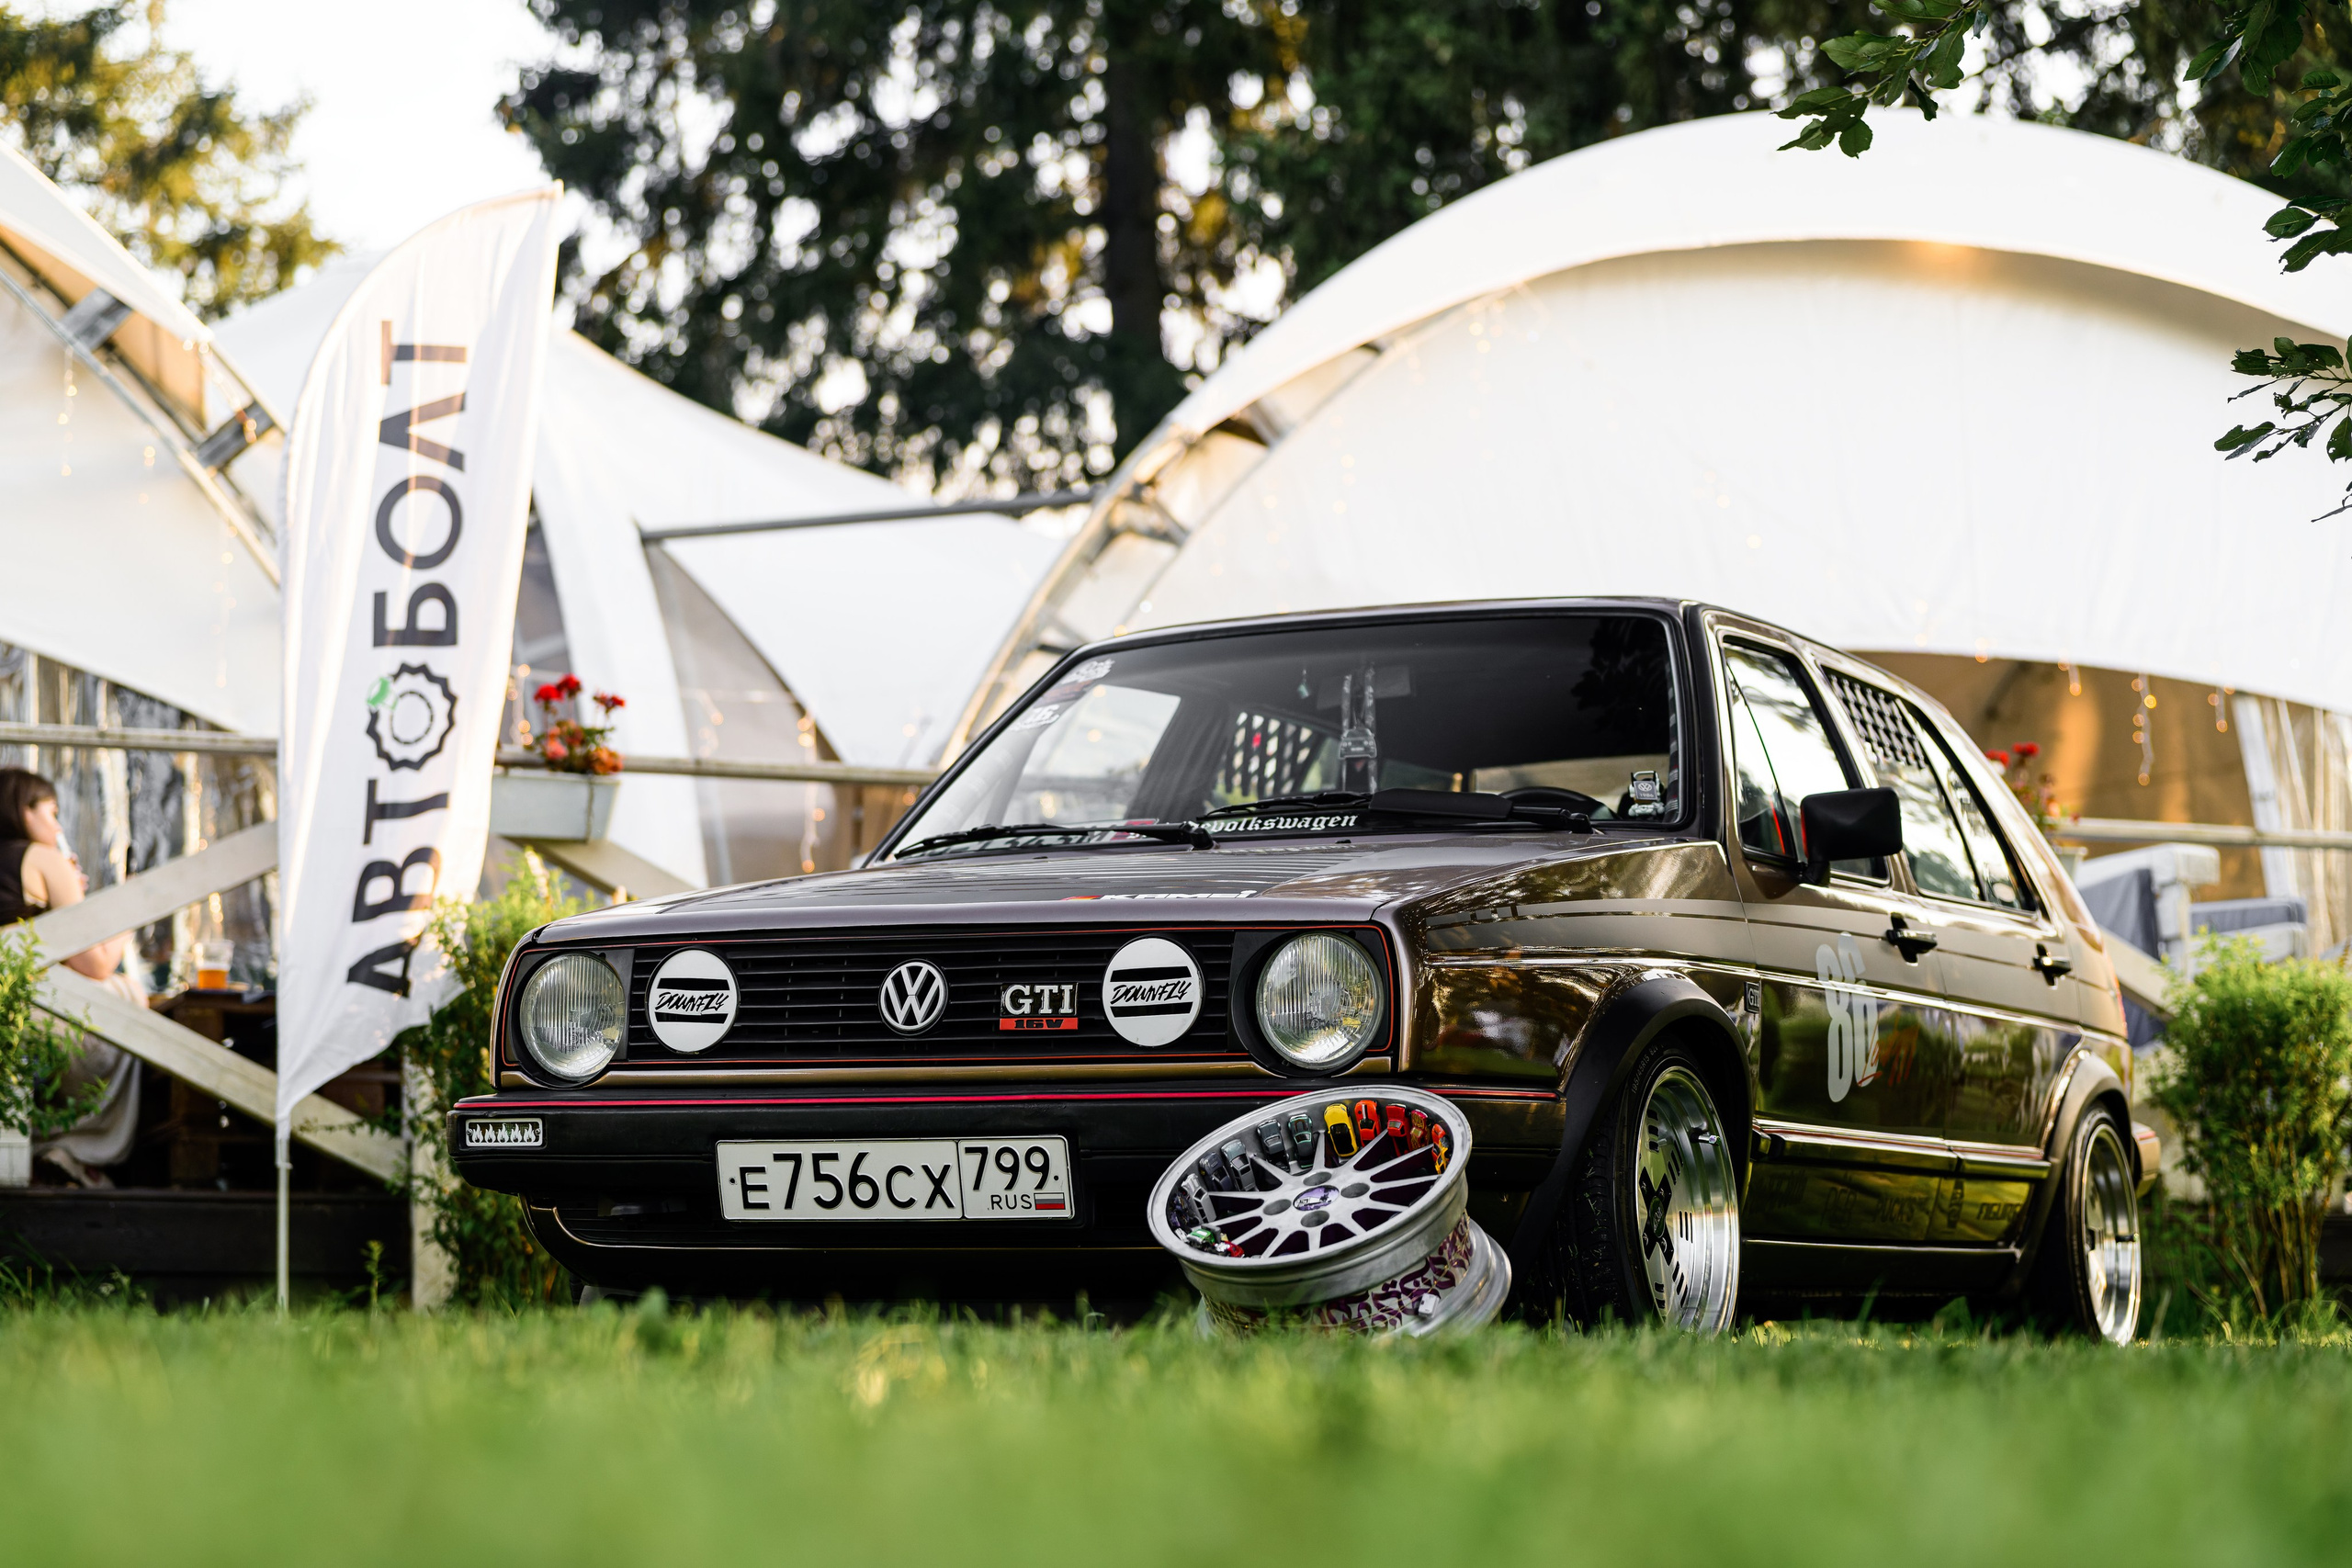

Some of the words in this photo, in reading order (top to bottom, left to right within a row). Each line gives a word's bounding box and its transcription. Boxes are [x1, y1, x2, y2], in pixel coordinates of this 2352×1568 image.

[1004, 984, 1074, 1015] GTI
[1014, 1019, 1064, 1029] 16V
[739, 1151, 956, 1210] E756CX
[965, 1145, 1050, 1190] 799
[992, 1194, 1033, 1211] RUS
